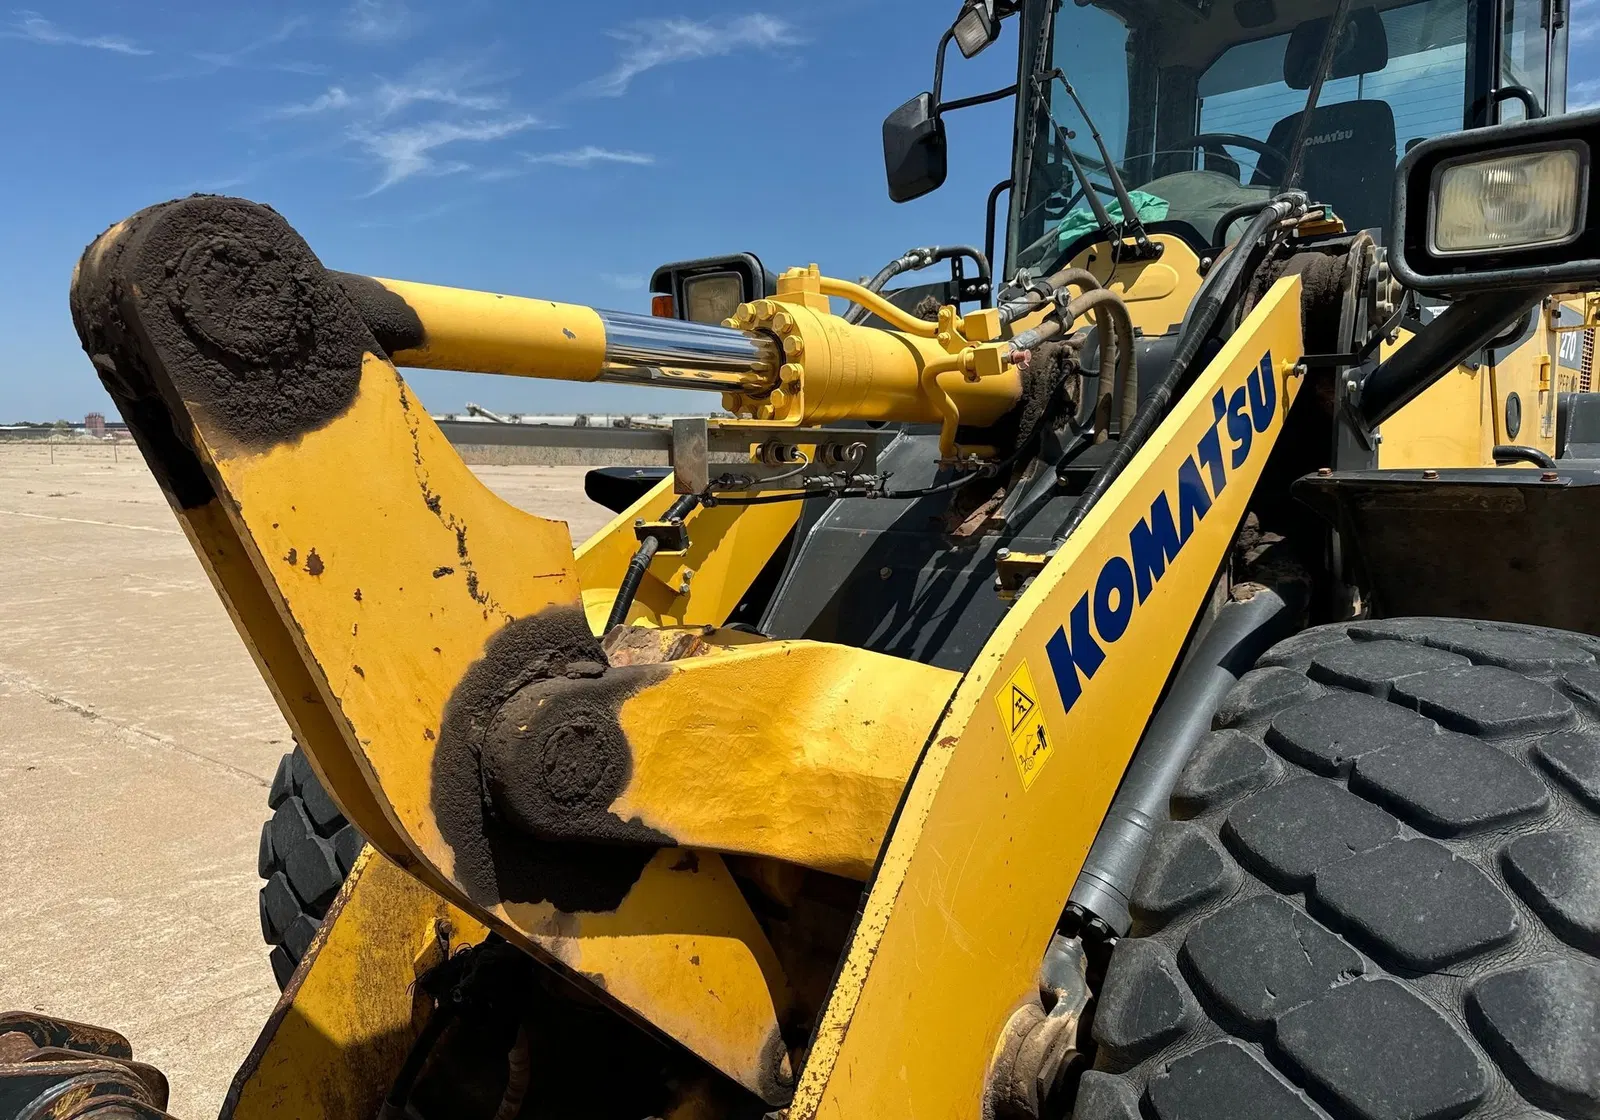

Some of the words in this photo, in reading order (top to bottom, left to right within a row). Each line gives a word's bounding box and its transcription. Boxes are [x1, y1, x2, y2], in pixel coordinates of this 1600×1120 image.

[1302, 129, 1354, 147] OMATSU
[1559, 331, 1577, 362] 270
[1045, 349, 1277, 714] KOMATSU
